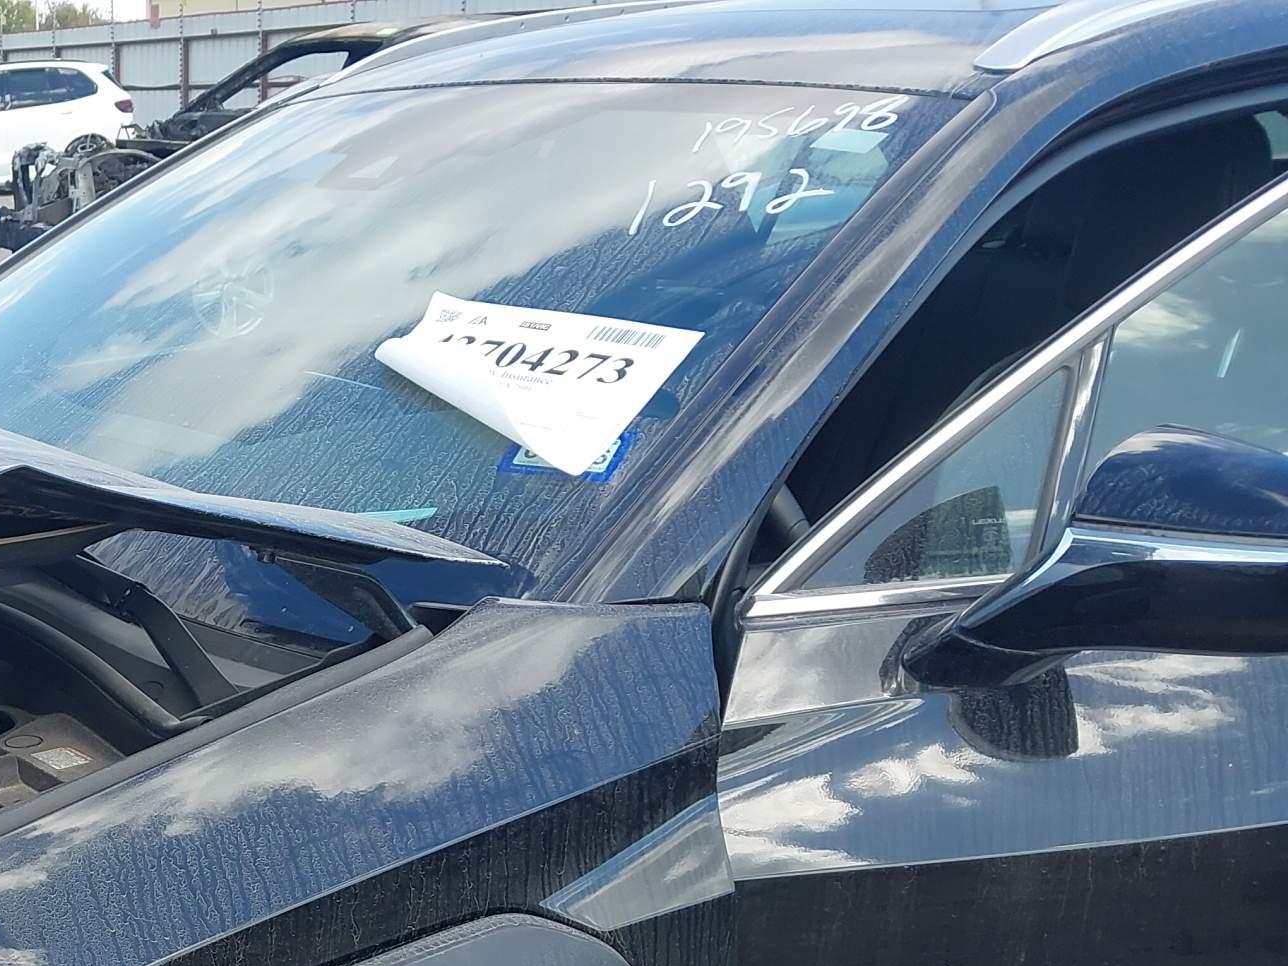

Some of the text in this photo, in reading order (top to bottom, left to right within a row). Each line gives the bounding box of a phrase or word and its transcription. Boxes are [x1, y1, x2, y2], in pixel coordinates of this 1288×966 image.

[692, 94, 911, 152] 195698
[628, 168, 835, 236] 1292
[439, 333, 635, 384] 704273
